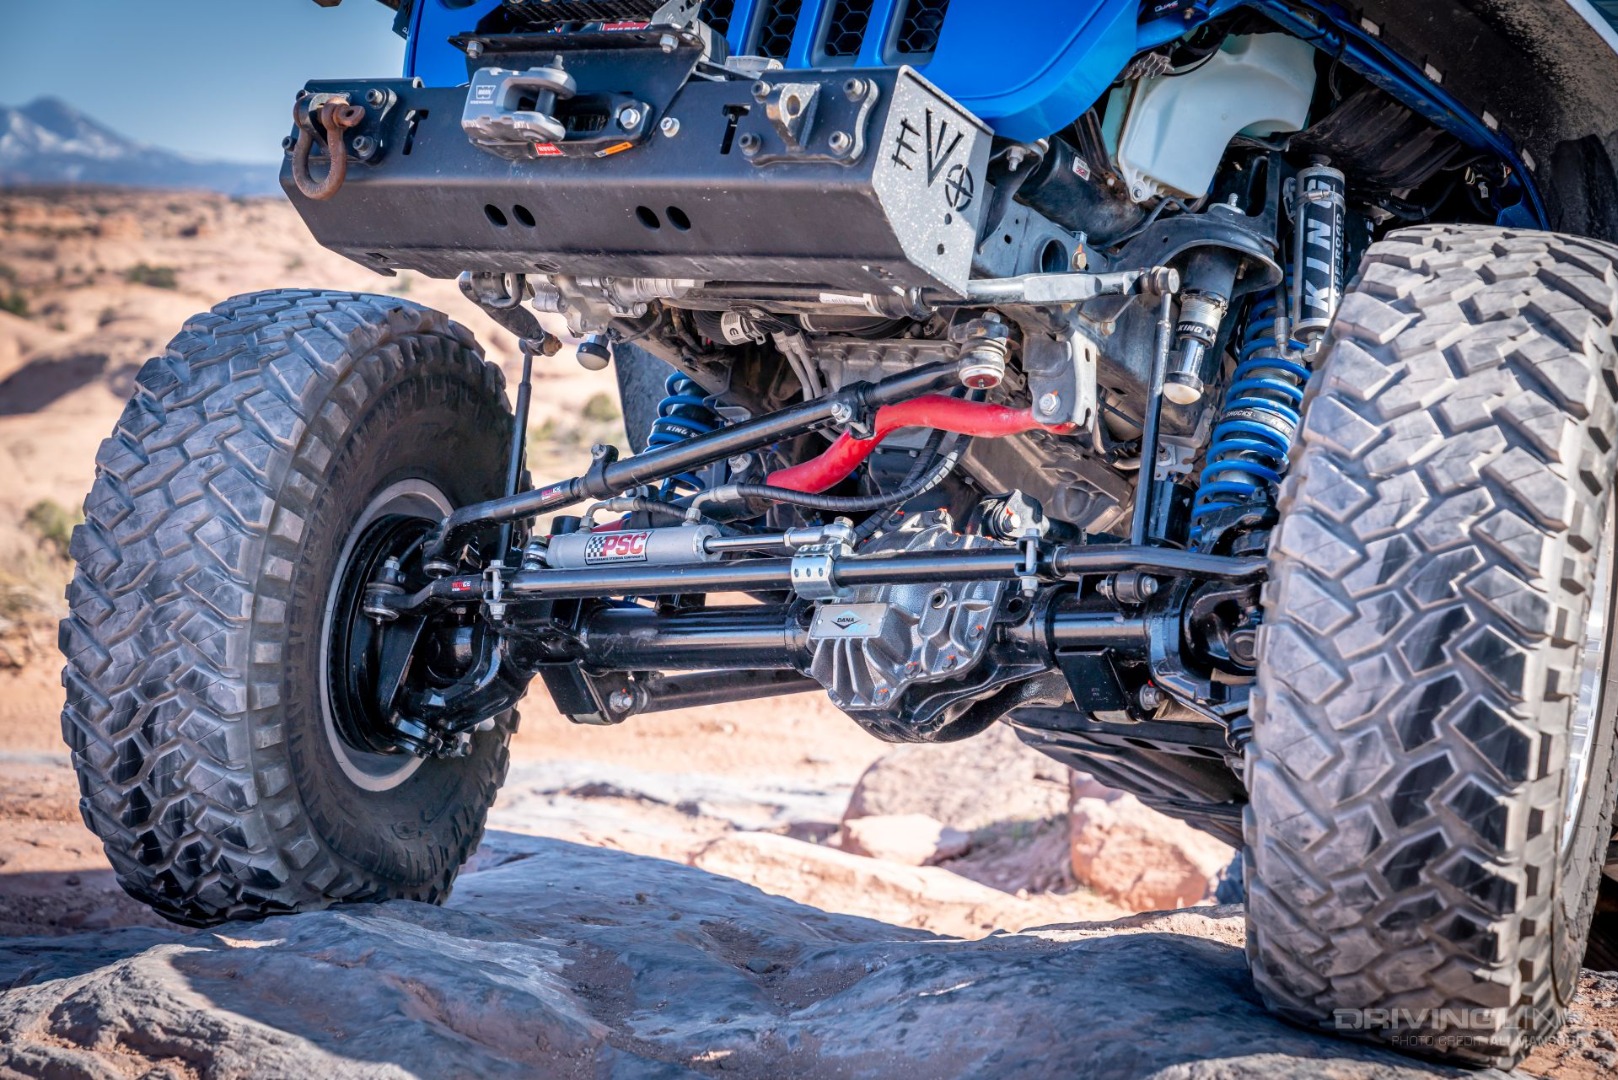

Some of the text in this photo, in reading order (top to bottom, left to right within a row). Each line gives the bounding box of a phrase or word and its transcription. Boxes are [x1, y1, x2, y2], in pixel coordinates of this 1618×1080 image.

[1305, 178, 1332, 313] KING
[1178, 324, 1204, 334] KING
[665, 425, 688, 435] KING
[602, 532, 647, 557] PSC
